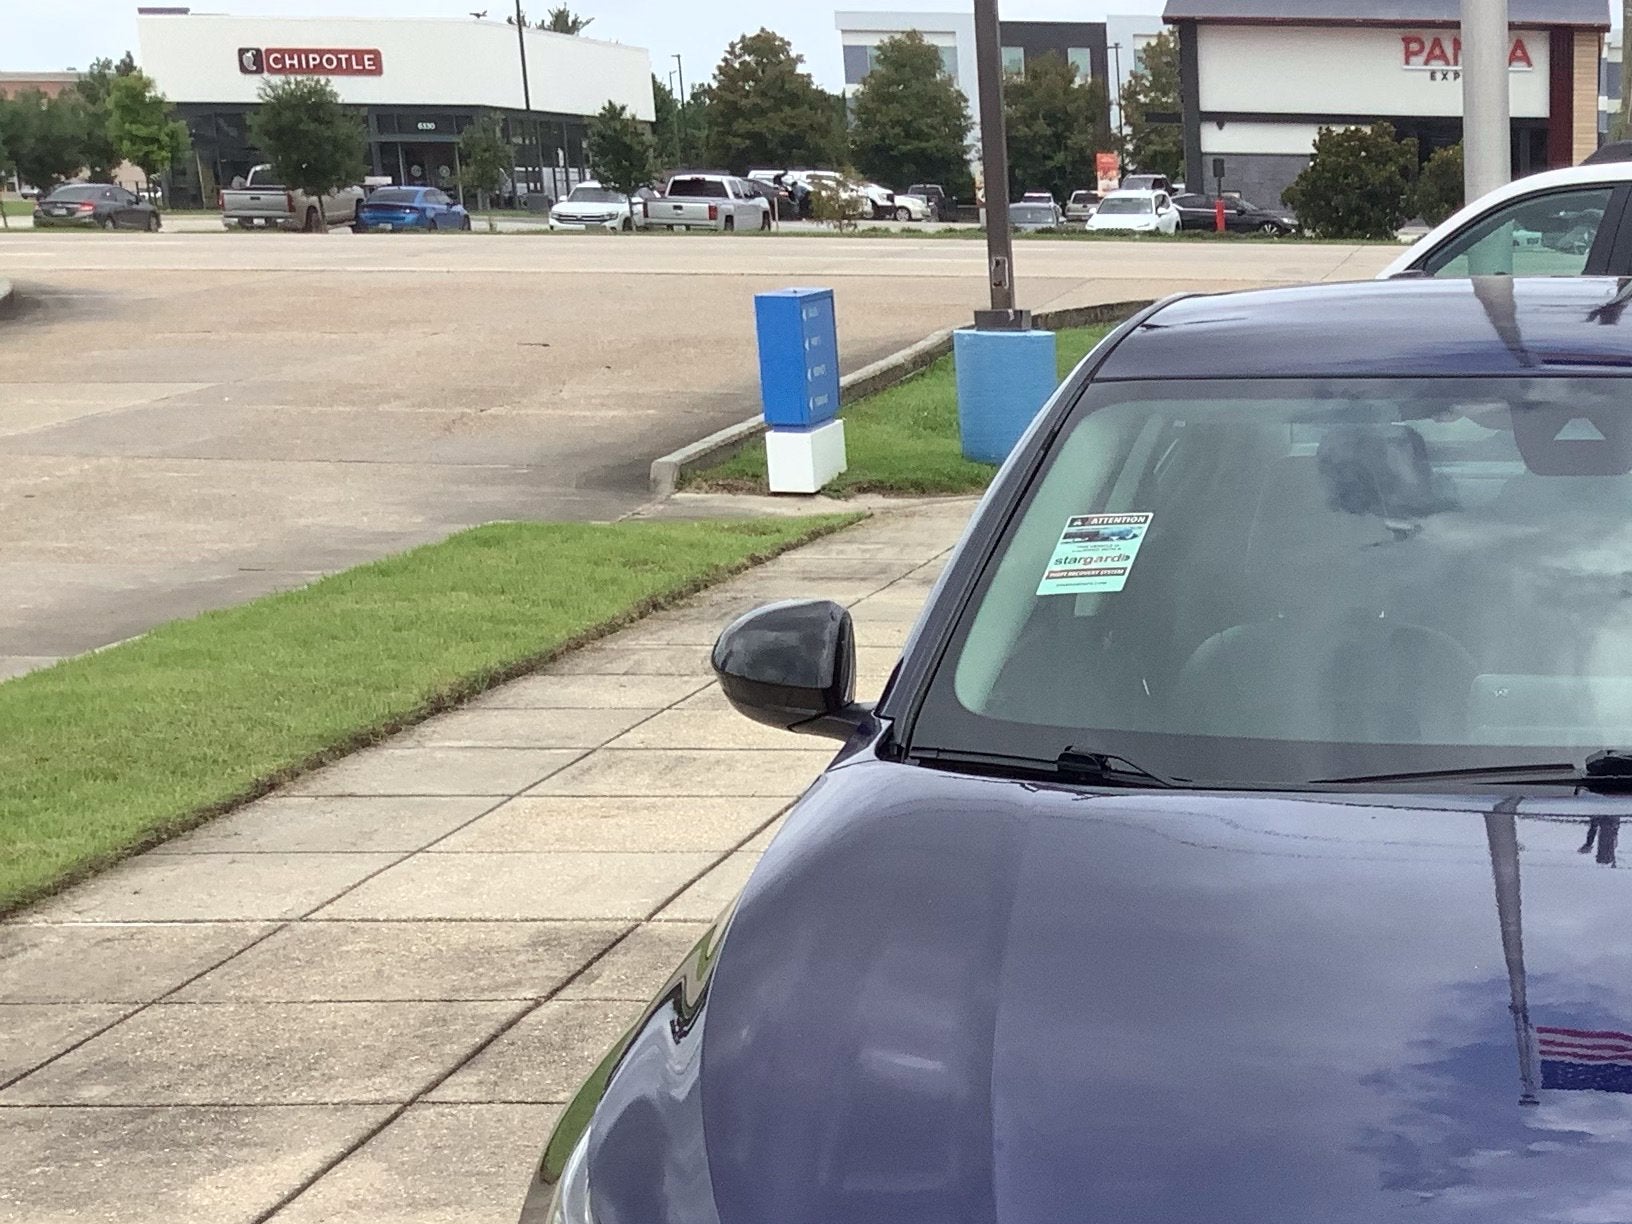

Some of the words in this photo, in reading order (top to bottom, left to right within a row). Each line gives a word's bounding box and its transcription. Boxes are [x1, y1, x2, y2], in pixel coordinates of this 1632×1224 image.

[1401, 36, 1534, 68] PAA
[269, 53, 377, 70] CHIPOTLE
[1091, 515, 1146, 525] ATTENTION
